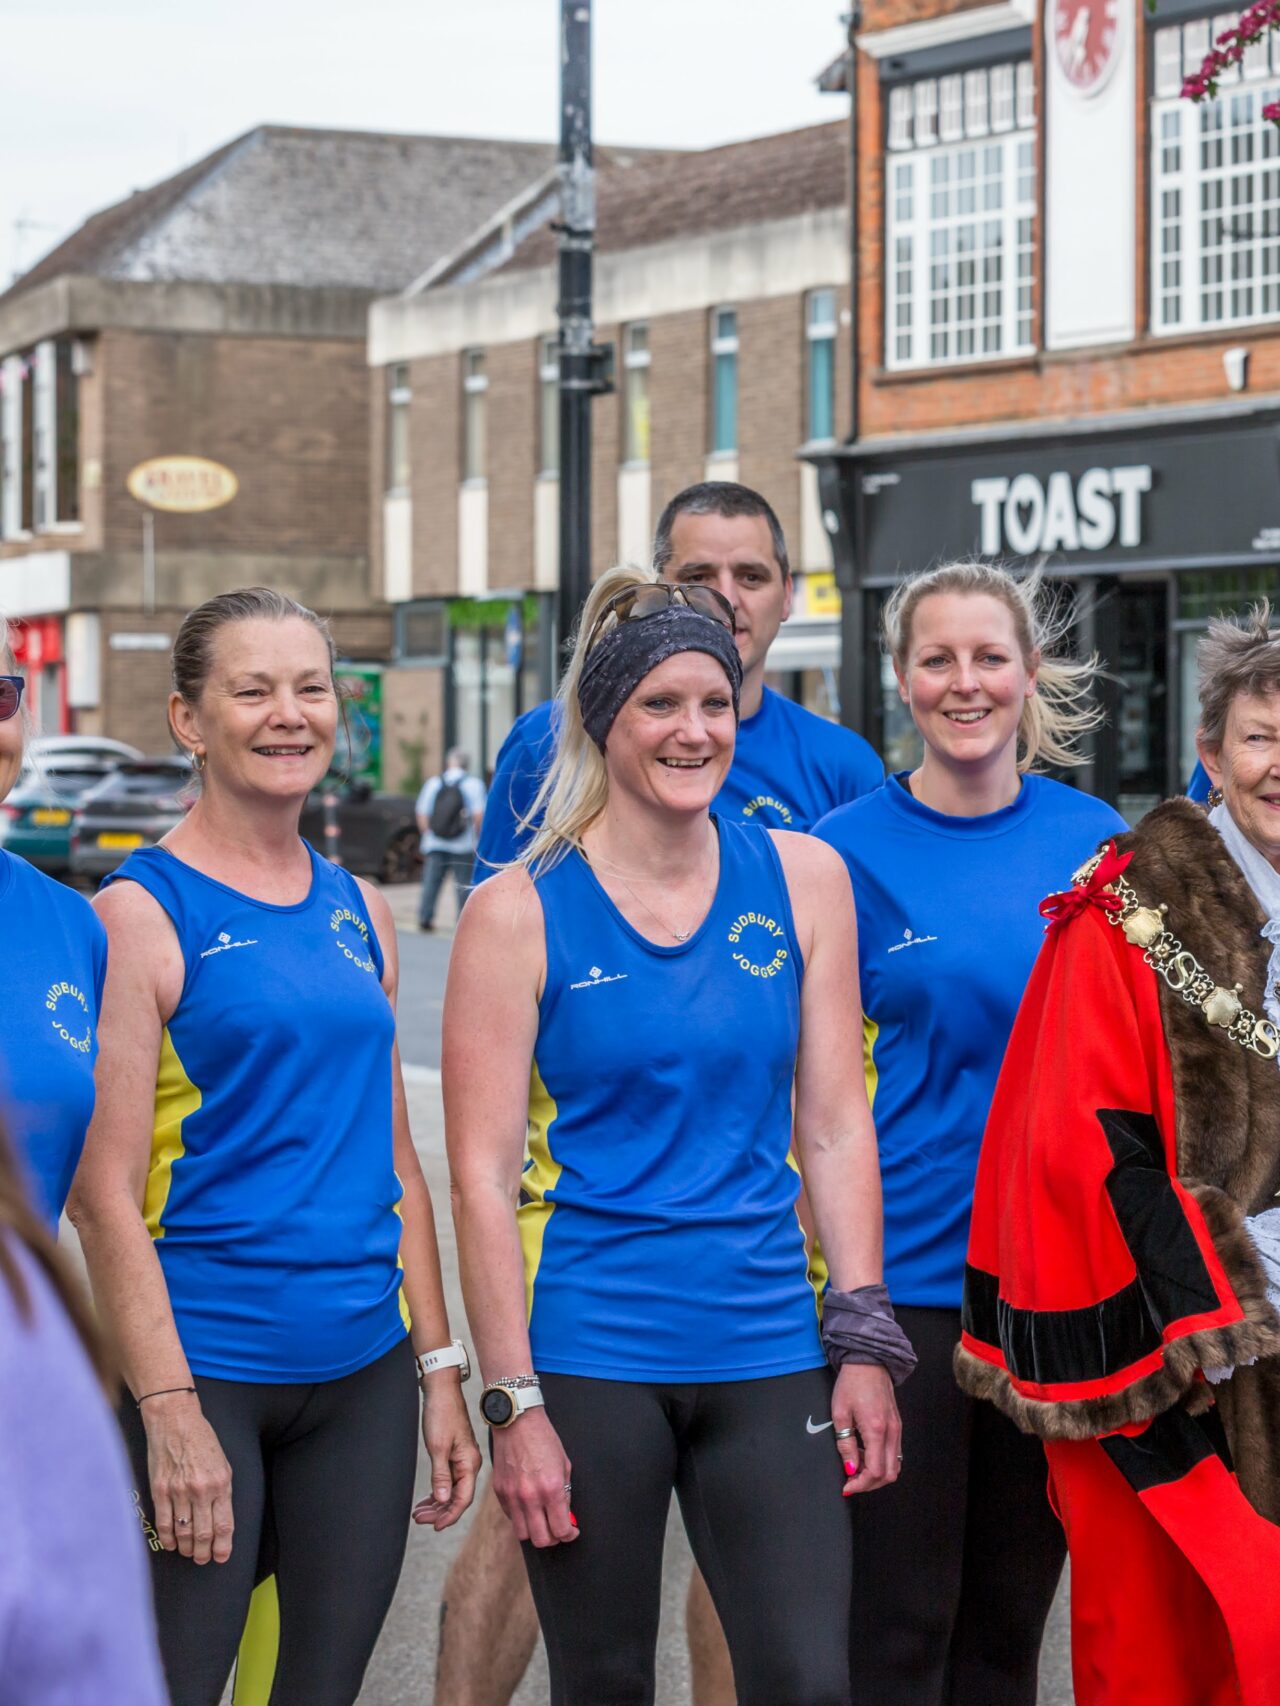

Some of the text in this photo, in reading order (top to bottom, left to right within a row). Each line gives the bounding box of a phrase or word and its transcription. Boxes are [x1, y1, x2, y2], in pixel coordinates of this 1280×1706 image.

[972, 465, 1151, 555] TOAST
[742, 795, 792, 825] SUDBURY
[330, 908, 369, 943] SUDBURY
[727, 911, 784, 943] SUDBURY
[732, 947, 788, 979] JOGGERS
[45, 981, 89, 1012] SUDBURY
[570, 972, 628, 990] RONHILL
